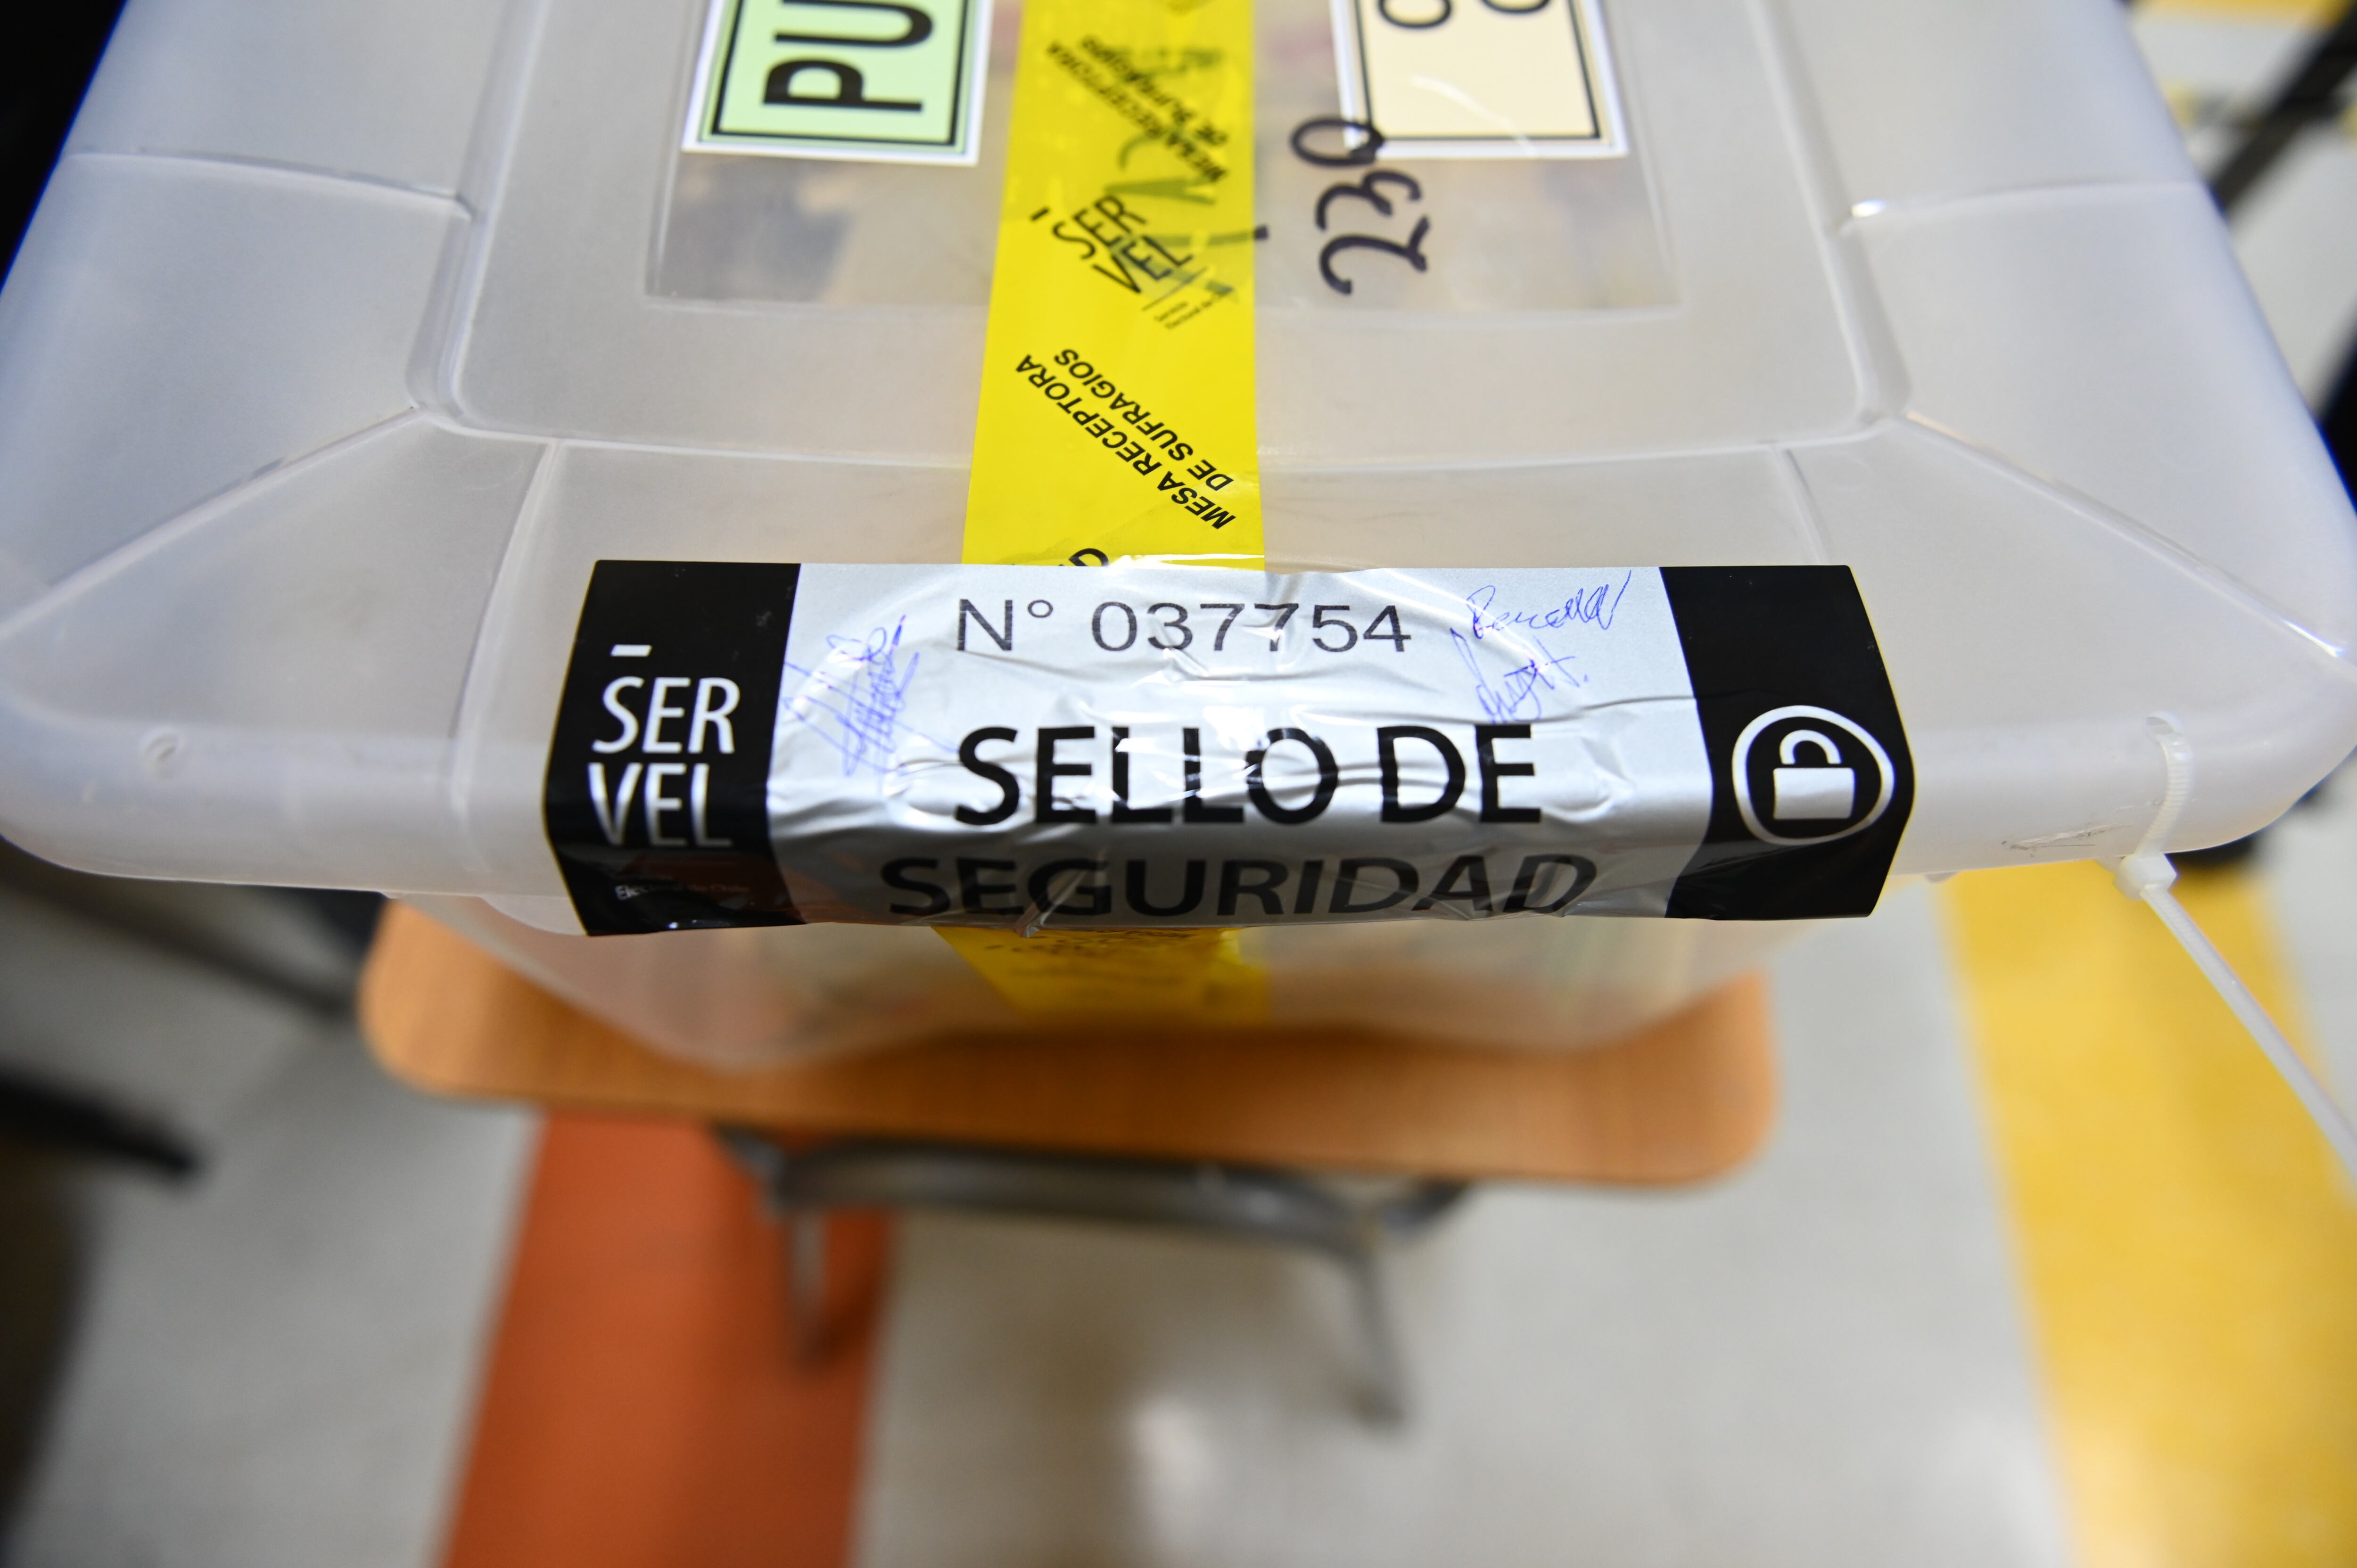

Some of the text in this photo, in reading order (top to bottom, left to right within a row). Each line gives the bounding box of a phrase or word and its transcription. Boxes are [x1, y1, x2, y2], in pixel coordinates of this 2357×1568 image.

[1052, 195, 1147, 260] SER
[1092, 235, 1194, 294] VEL
[1015, 354, 1236, 530] MESA RECEPTORA
[1054, 348, 1234, 492] DE SUFRAGIOS
[957, 598, 1054, 652] N°
[1091, 601, 1411, 653] 037754
[592, 676, 741, 754] SER
[587, 762, 733, 846] VEL
[955, 723, 1542, 826] SELLO DE
[881, 854, 1598, 918] SEGURIDAD
